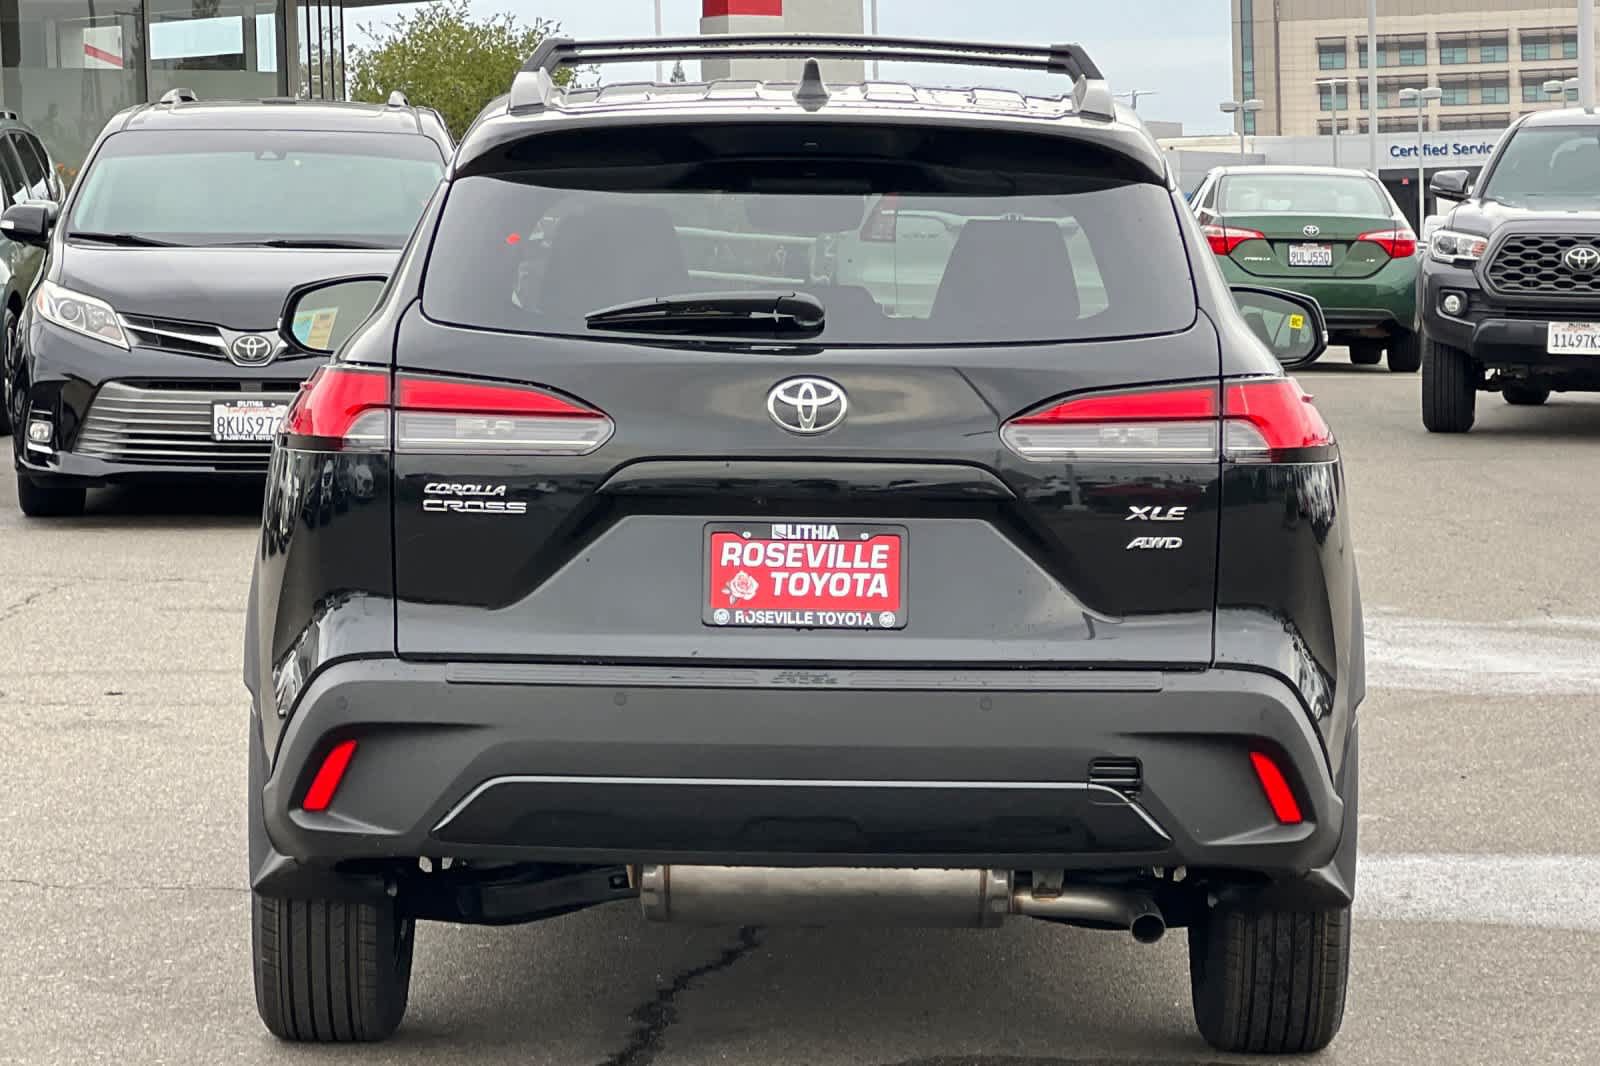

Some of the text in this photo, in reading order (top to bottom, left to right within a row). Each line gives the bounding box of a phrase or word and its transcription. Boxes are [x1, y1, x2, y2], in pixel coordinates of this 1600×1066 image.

[1390, 142, 1495, 157] Certfied Servic
[424, 482, 507, 497] COROLLA
[423, 499, 528, 514] CROSS
[1125, 505, 1188, 521] XLE
[787, 524, 840, 540] LITHIA
[1126, 536, 1183, 550] AWD
[720, 541, 890, 569] ROSEVILLE
[770, 571, 889, 598] TOYOTA
[735, 611, 874, 626] ROSEVILLE TOYOTA
